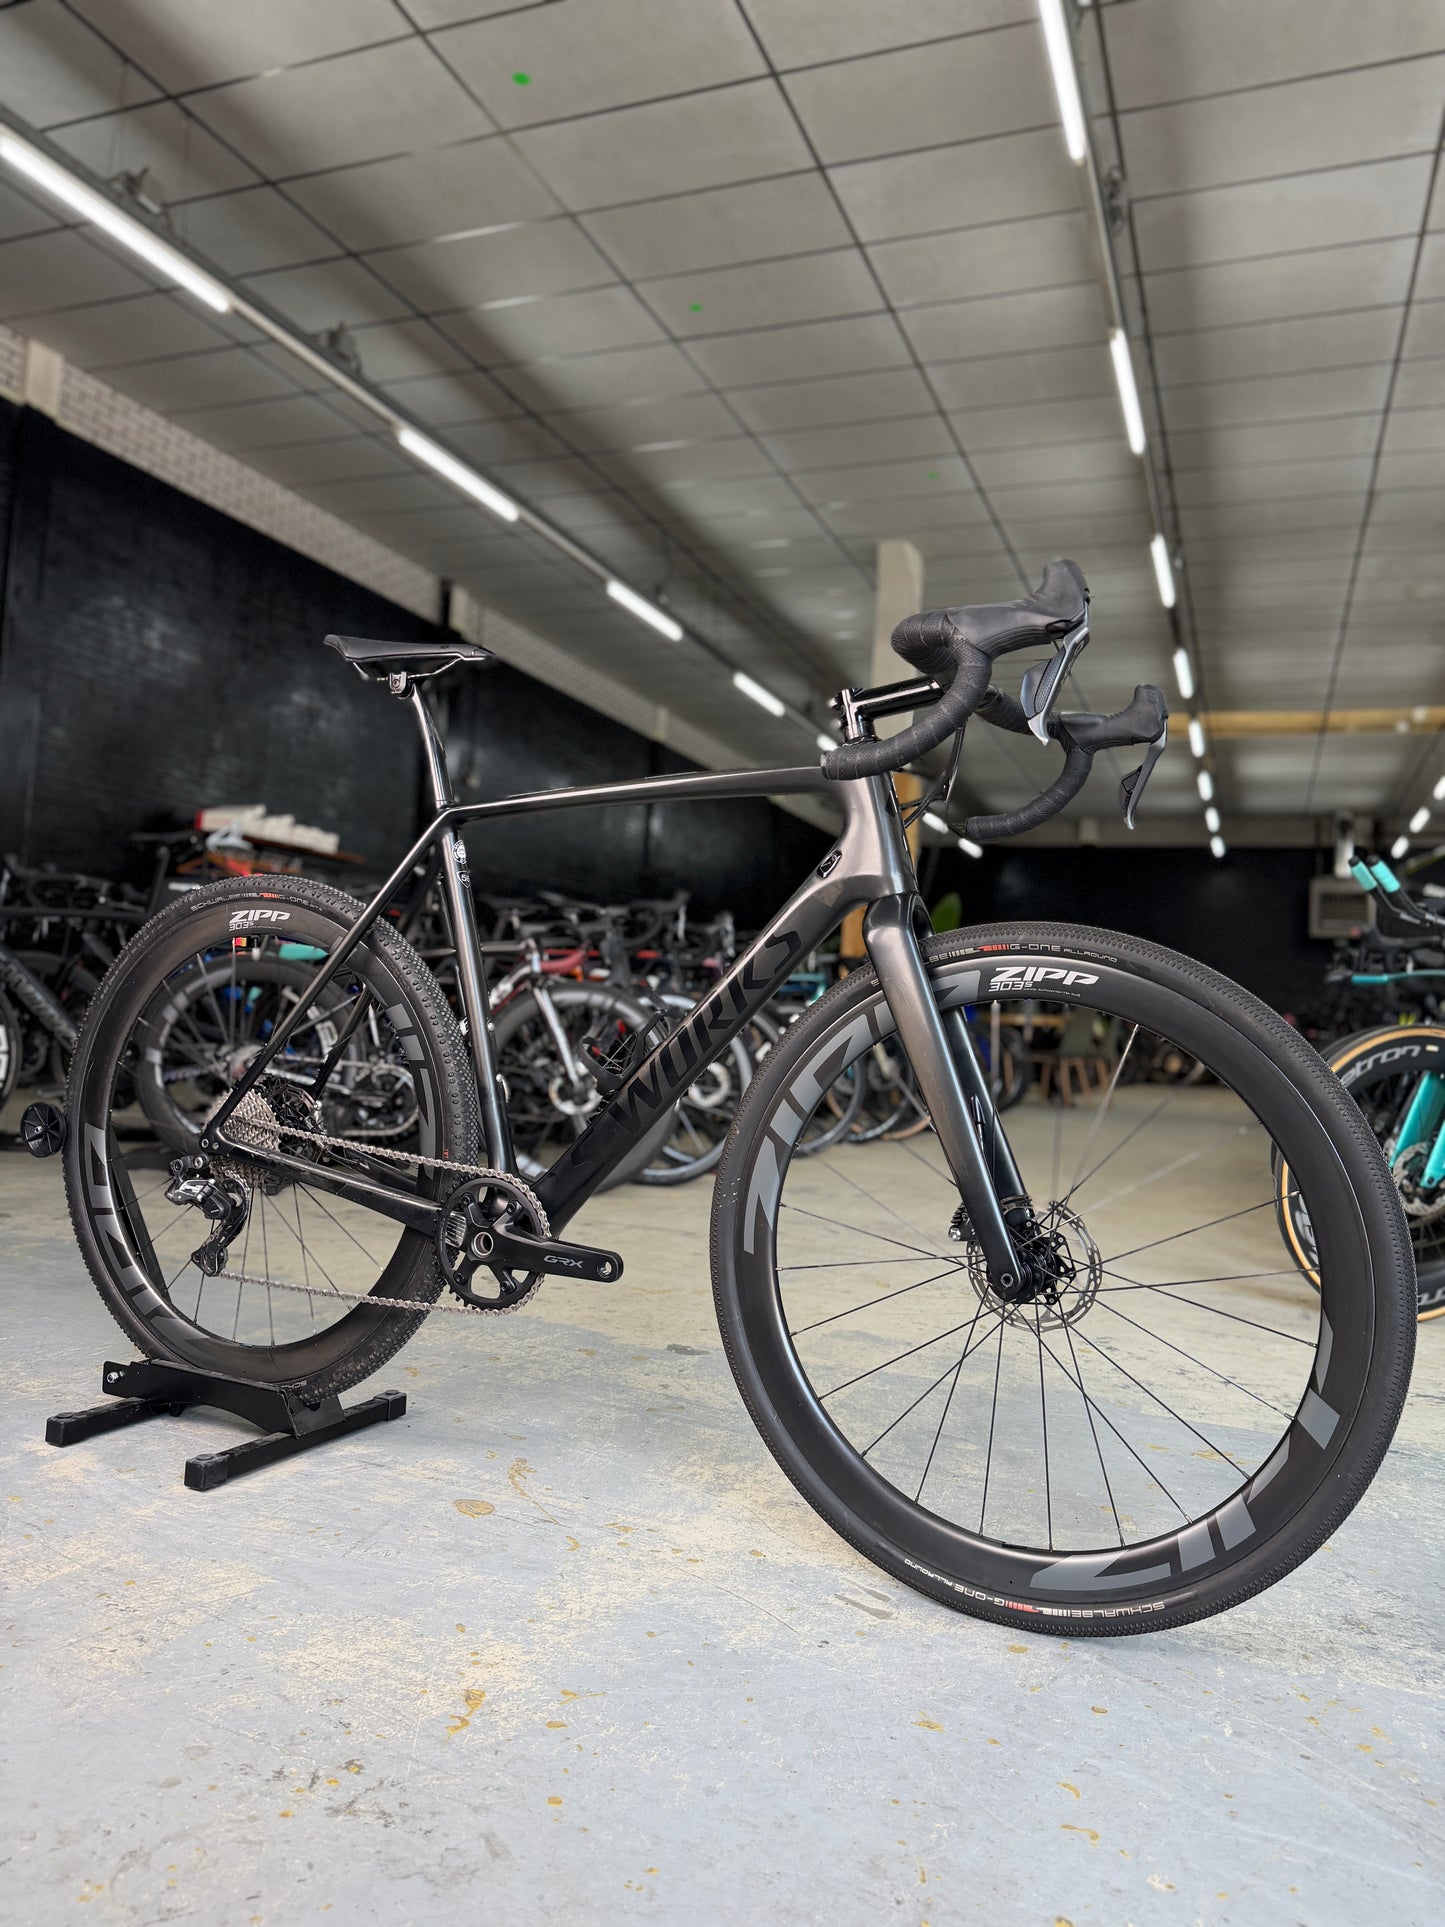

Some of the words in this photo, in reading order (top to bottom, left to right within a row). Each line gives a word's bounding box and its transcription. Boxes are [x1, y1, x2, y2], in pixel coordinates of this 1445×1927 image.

[229, 910, 291, 923] ZIPP
[1010, 943, 1061, 953] G-ONE
[1063, 948, 1117, 963] ALLROUND
[990, 966, 1100, 986] ZIPP
[1340, 1045, 1421, 1088] etron
[544, 1255, 584, 1269] GRX
[954, 1584, 1005, 1607] G-ONE
[1070, 1601, 1166, 1618] SCHWALBE
